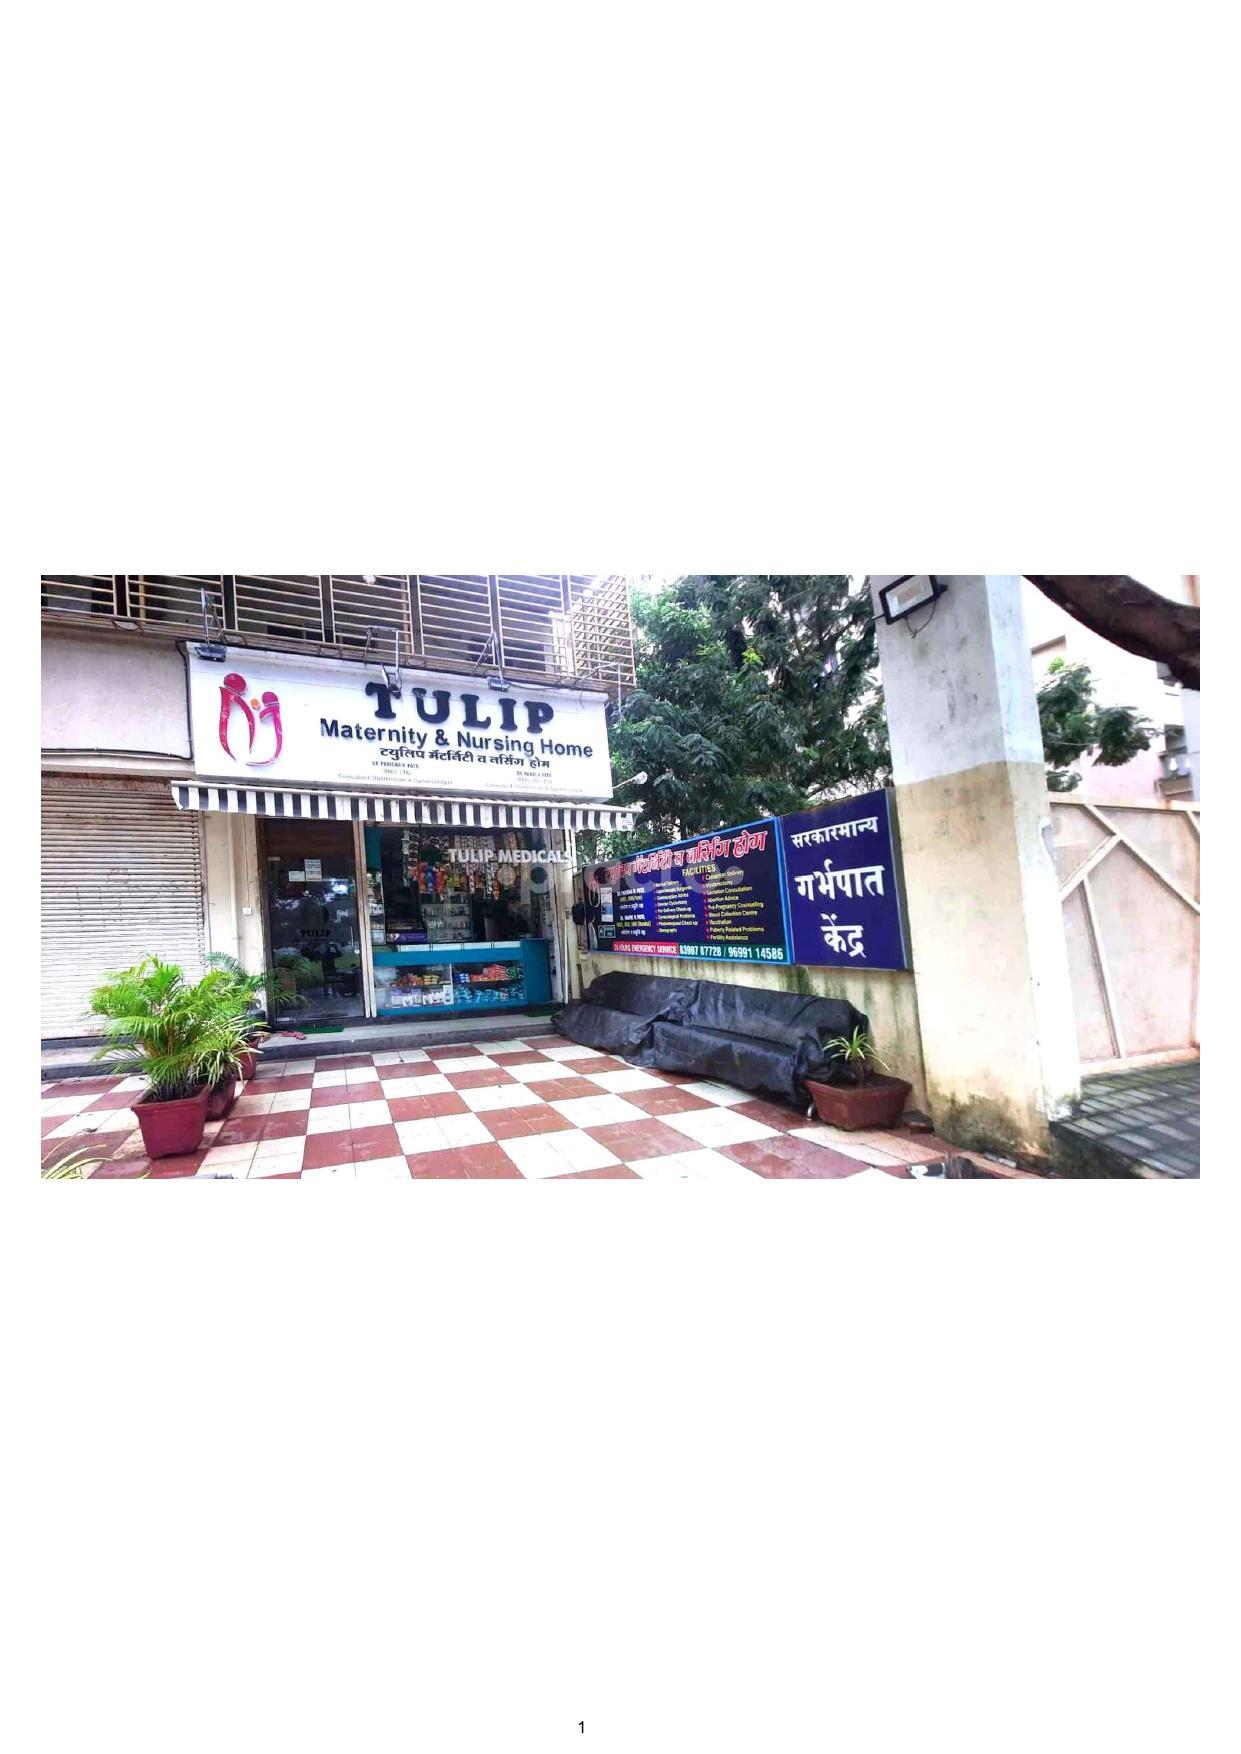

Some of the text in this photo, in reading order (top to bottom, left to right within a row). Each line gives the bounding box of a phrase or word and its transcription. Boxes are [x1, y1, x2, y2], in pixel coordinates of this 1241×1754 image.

[365, 682, 554, 733] TULIP
[320, 718, 593, 758] Maternity & Nursing Home
[477, 754, 486, 764] व
[489, 754, 524, 767] नर्सिंग
[528, 756, 550, 768] होम
[732, 830, 767, 858] होम
[790, 816, 879, 849] सरकारमान्य
[448, 849, 573, 863] TULIP MEDICALS
[682, 863, 716, 876] FACILITIES
[794, 858, 885, 902] गर्भपात
[631, 944, 656, 953] EMERGENCY
[657, 945, 677, 954] SERVICE
[820, 912, 867, 959] केंद्र
[728, 946, 753, 958] 96991
[755, 946, 784, 960] 14586
